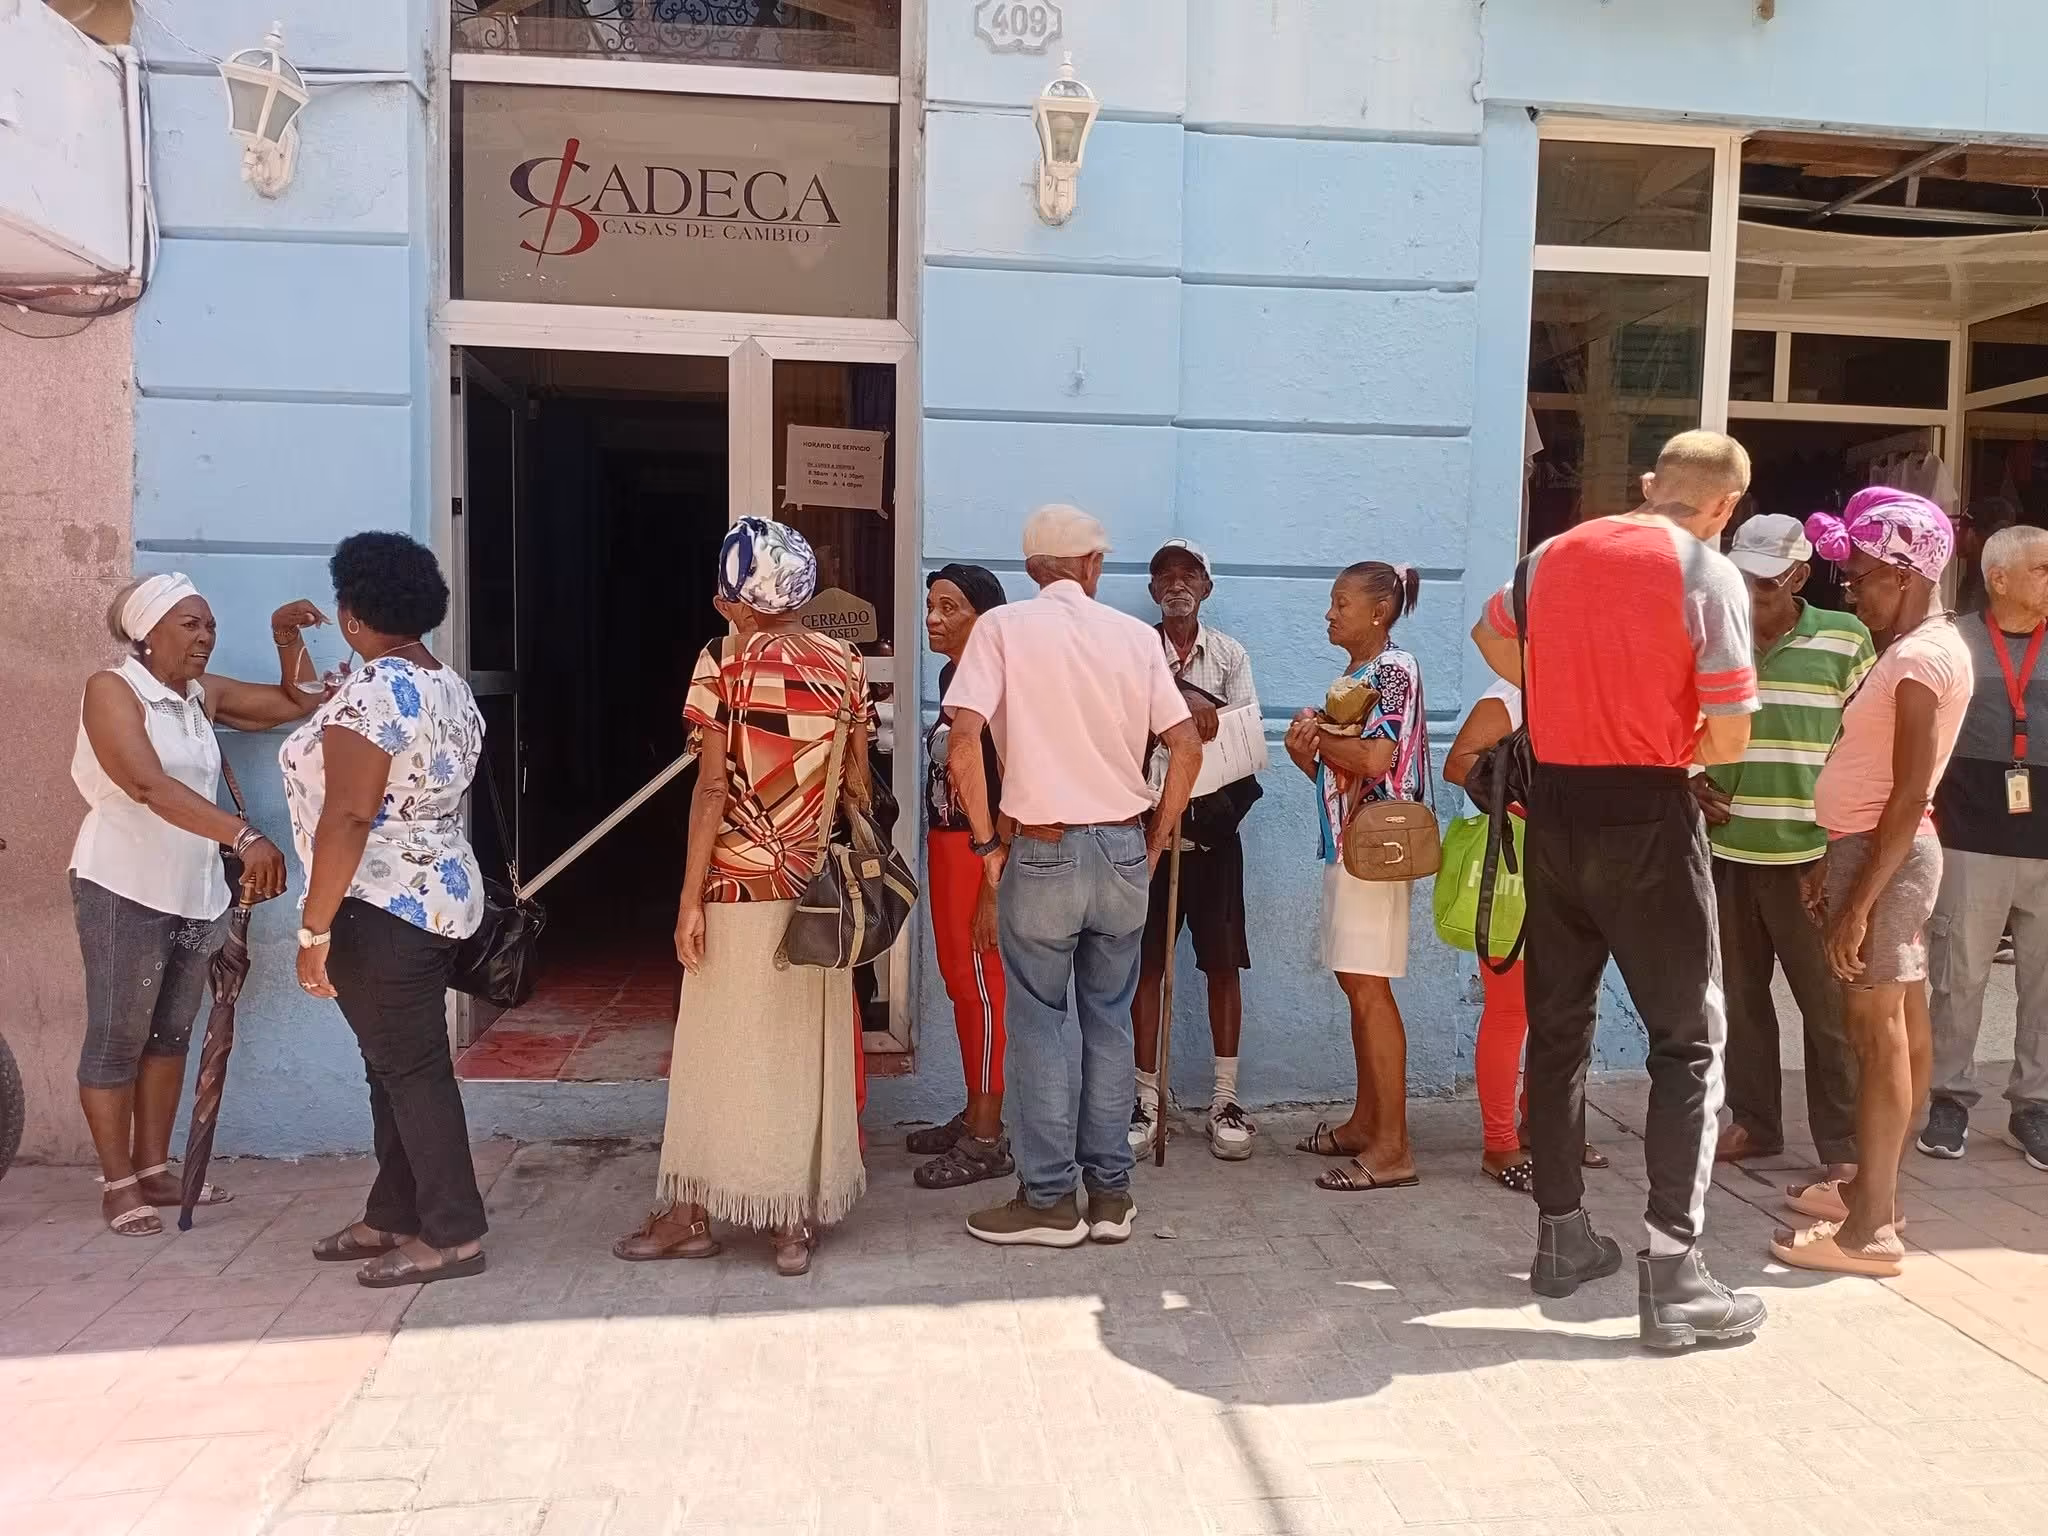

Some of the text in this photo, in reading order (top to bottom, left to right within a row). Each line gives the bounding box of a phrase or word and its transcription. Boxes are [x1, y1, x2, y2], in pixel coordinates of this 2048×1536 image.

[991, 3, 1048, 38] 409
[601, 219, 811, 244] CASAS DE CAMBIO
[802, 441, 832, 449] HORARIO
[801, 610, 870, 628] CERRADO
[816, 627, 860, 639] OSED
